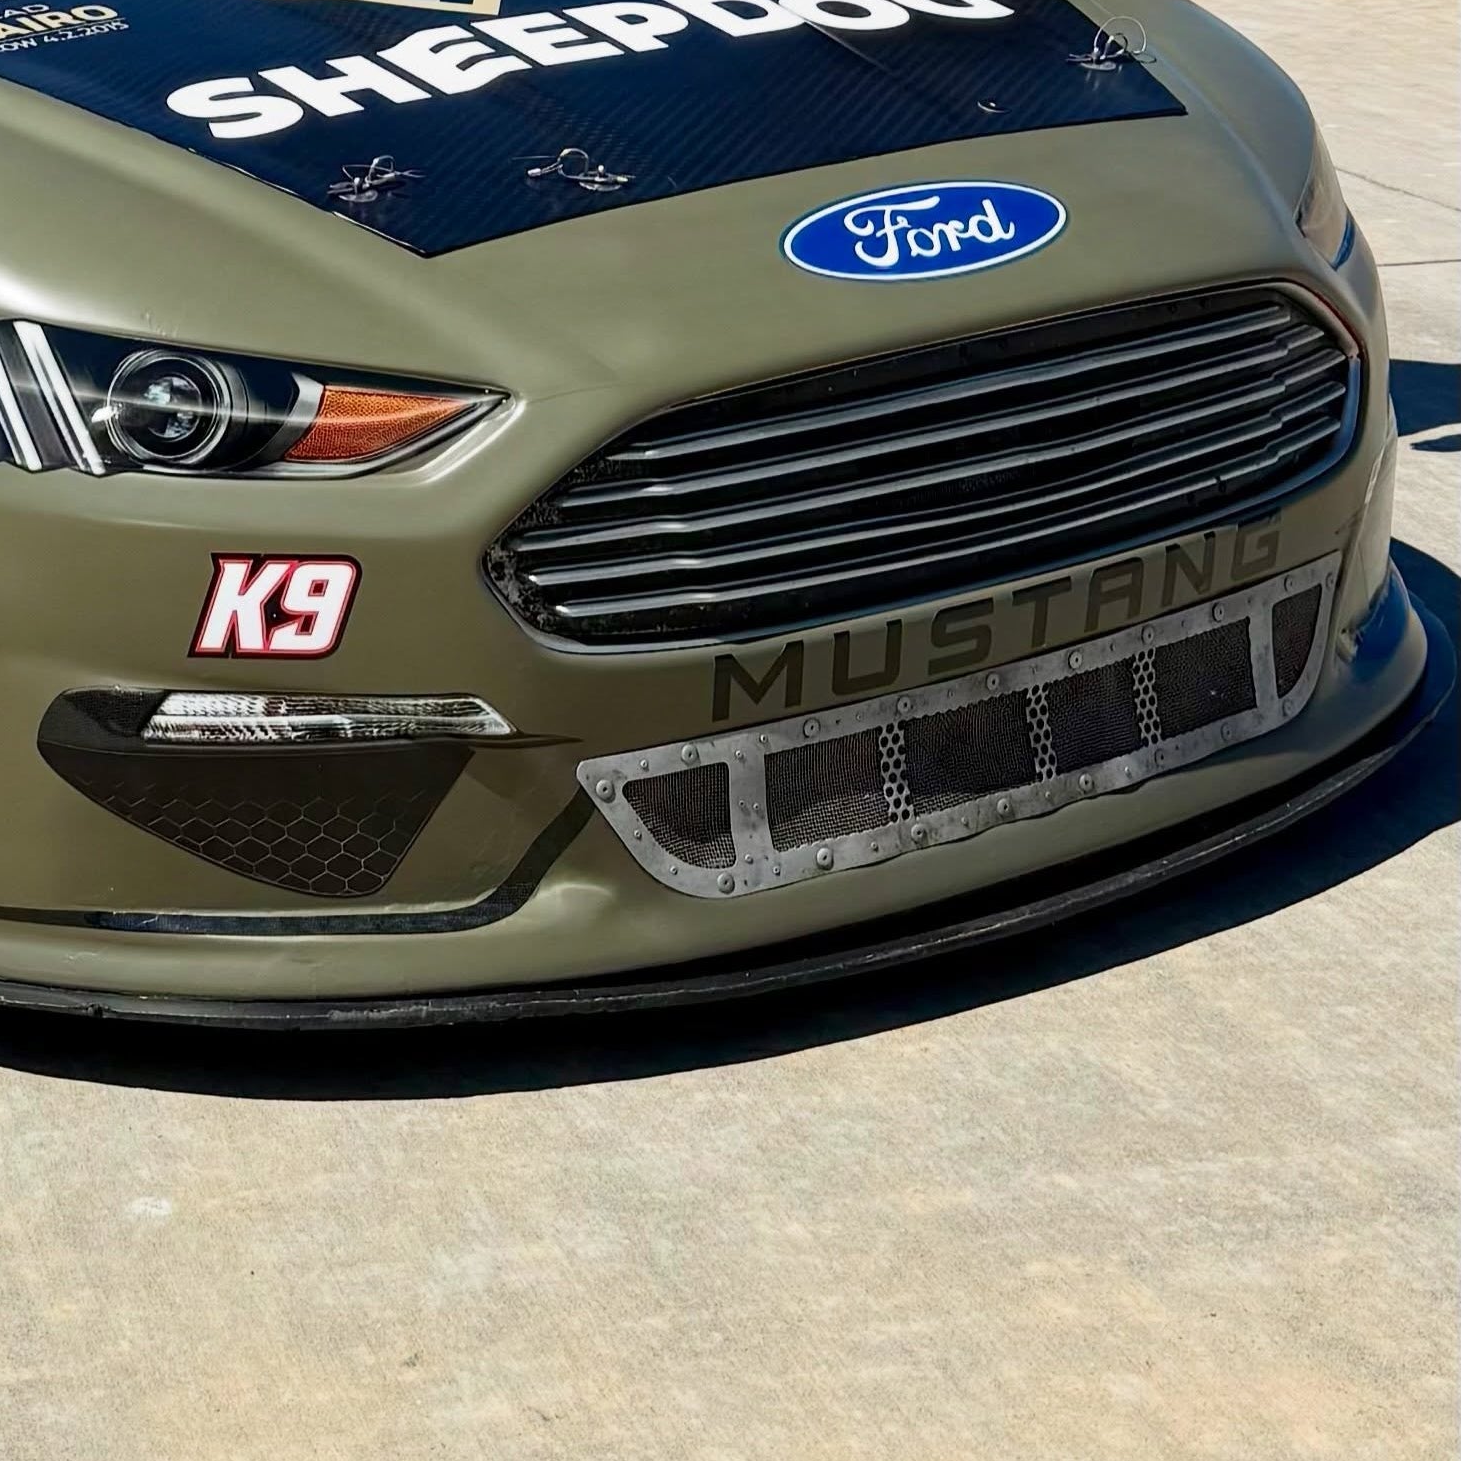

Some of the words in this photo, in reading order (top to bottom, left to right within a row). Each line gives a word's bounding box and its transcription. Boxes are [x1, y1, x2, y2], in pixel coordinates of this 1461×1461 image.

[844, 195, 1016, 268] Ford
[192, 557, 359, 655] K9
[712, 521, 1283, 723] MUSTANG
